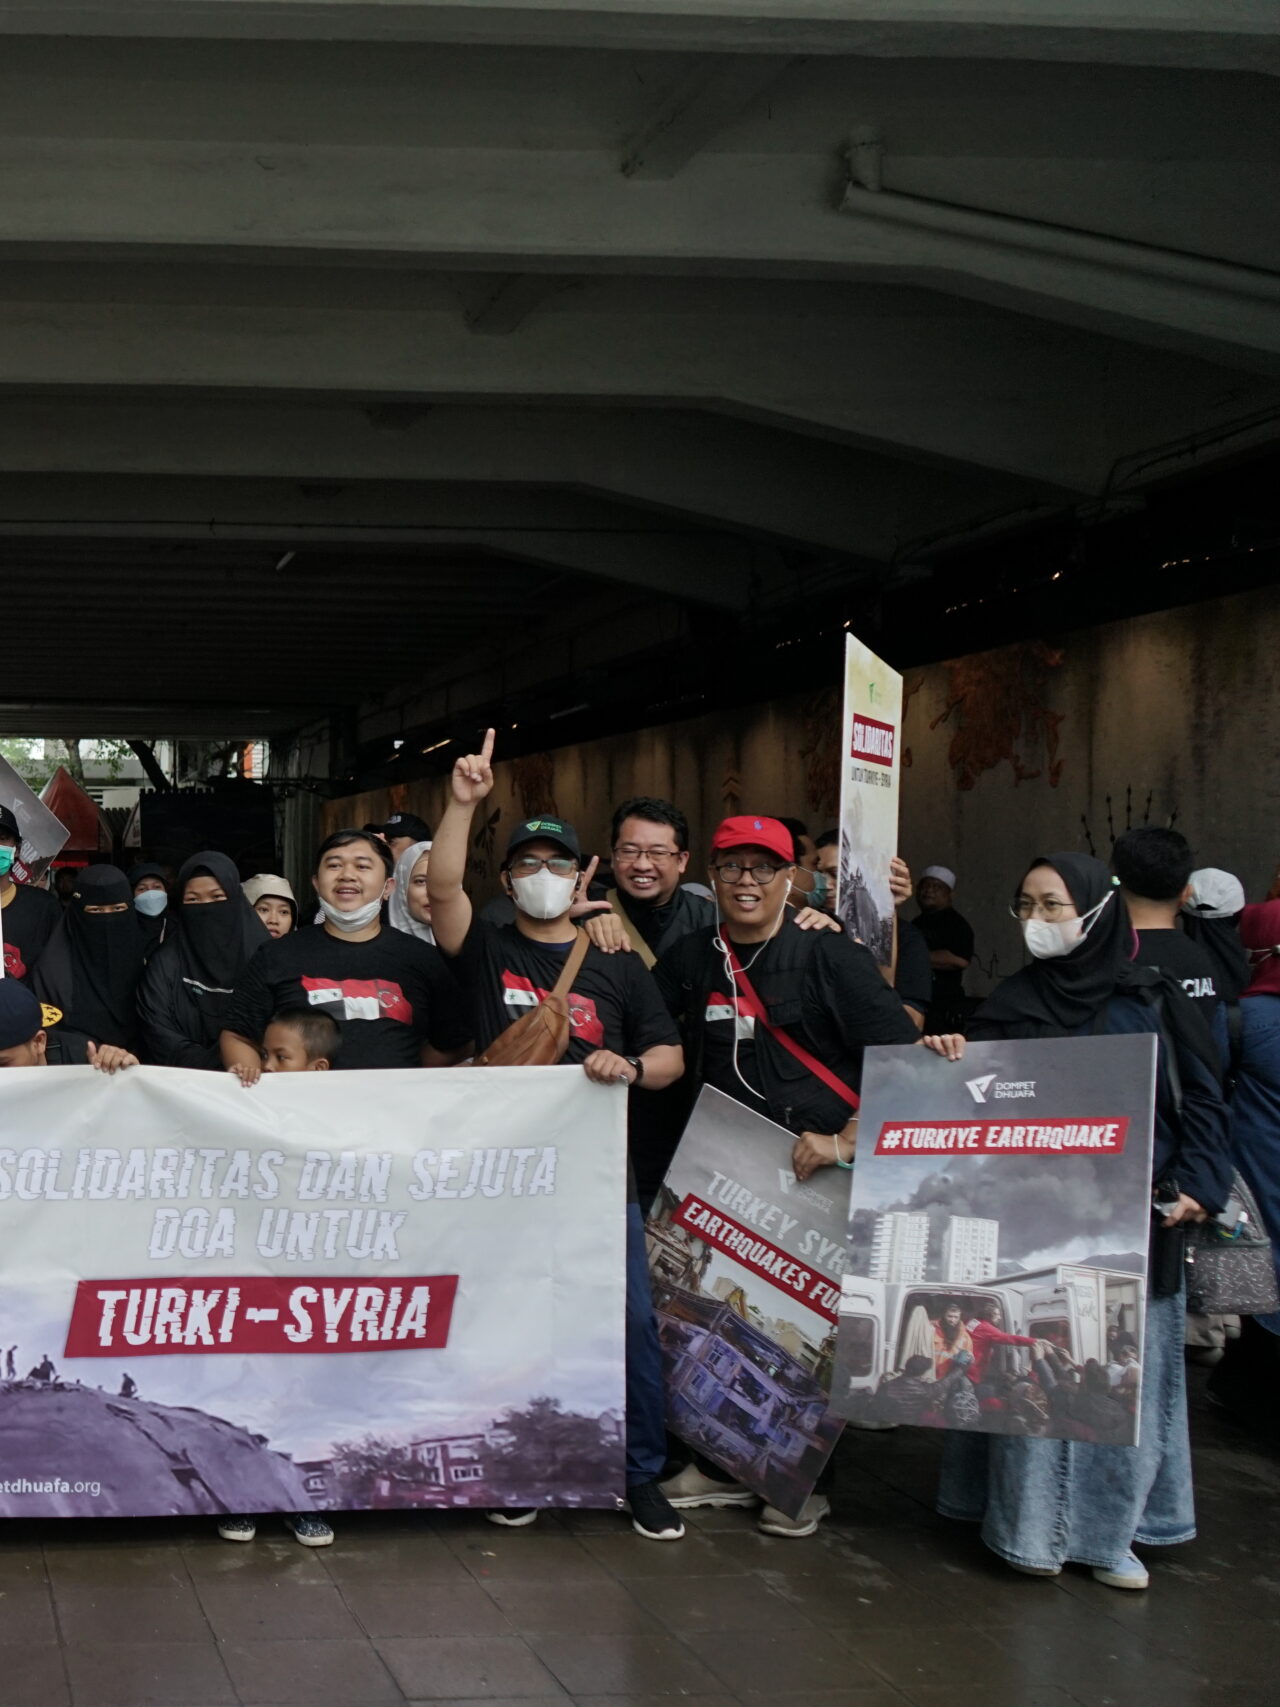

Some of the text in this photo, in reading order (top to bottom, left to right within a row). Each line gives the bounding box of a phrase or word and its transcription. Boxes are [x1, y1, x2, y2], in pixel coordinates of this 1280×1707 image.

[1181, 977, 1216, 998] CIAL
[994, 1081, 1036, 1091] DOMPET
[994, 1089, 1036, 1099] DHUAFA
[881, 1123, 1120, 1151] #TURKIYE EARTHQUAKE
[295, 1150, 393, 1203] DAN
[407, 1146, 559, 1200] SEJUTA
[706, 1170, 799, 1240] TURKEY
[147, 1207, 408, 1262] DOA UNTUK
[683, 1201, 812, 1292] EARTHQUAKES
